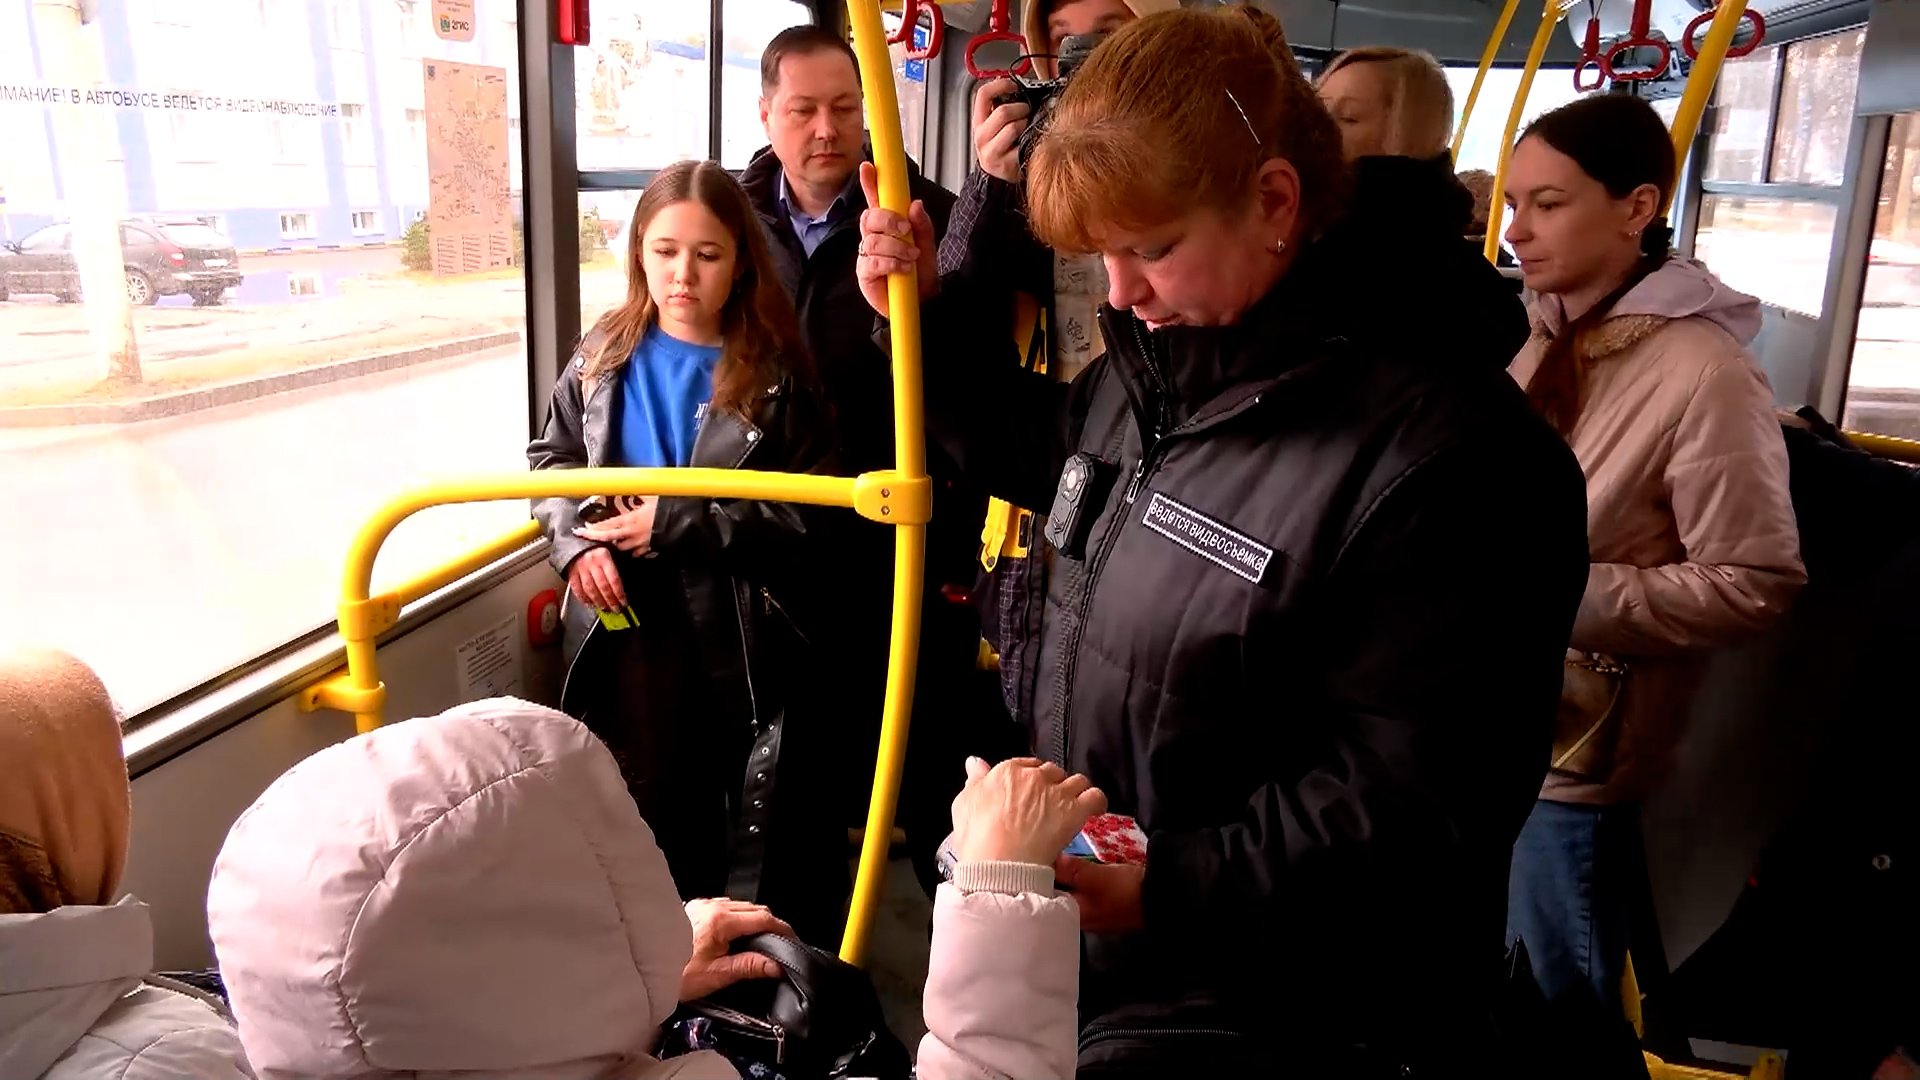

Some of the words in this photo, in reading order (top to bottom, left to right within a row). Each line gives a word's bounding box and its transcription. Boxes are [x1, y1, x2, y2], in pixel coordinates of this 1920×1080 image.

[0, 85, 66, 103] МАНИЕ!
[71, 89, 81, 104] В
[85, 90, 160, 108] АВТОБУСЕ
[225, 98, 337, 117] ВИДЕОНАБЛЮДЕНИЕ
[1188, 521, 1265, 571] видеосъемка
